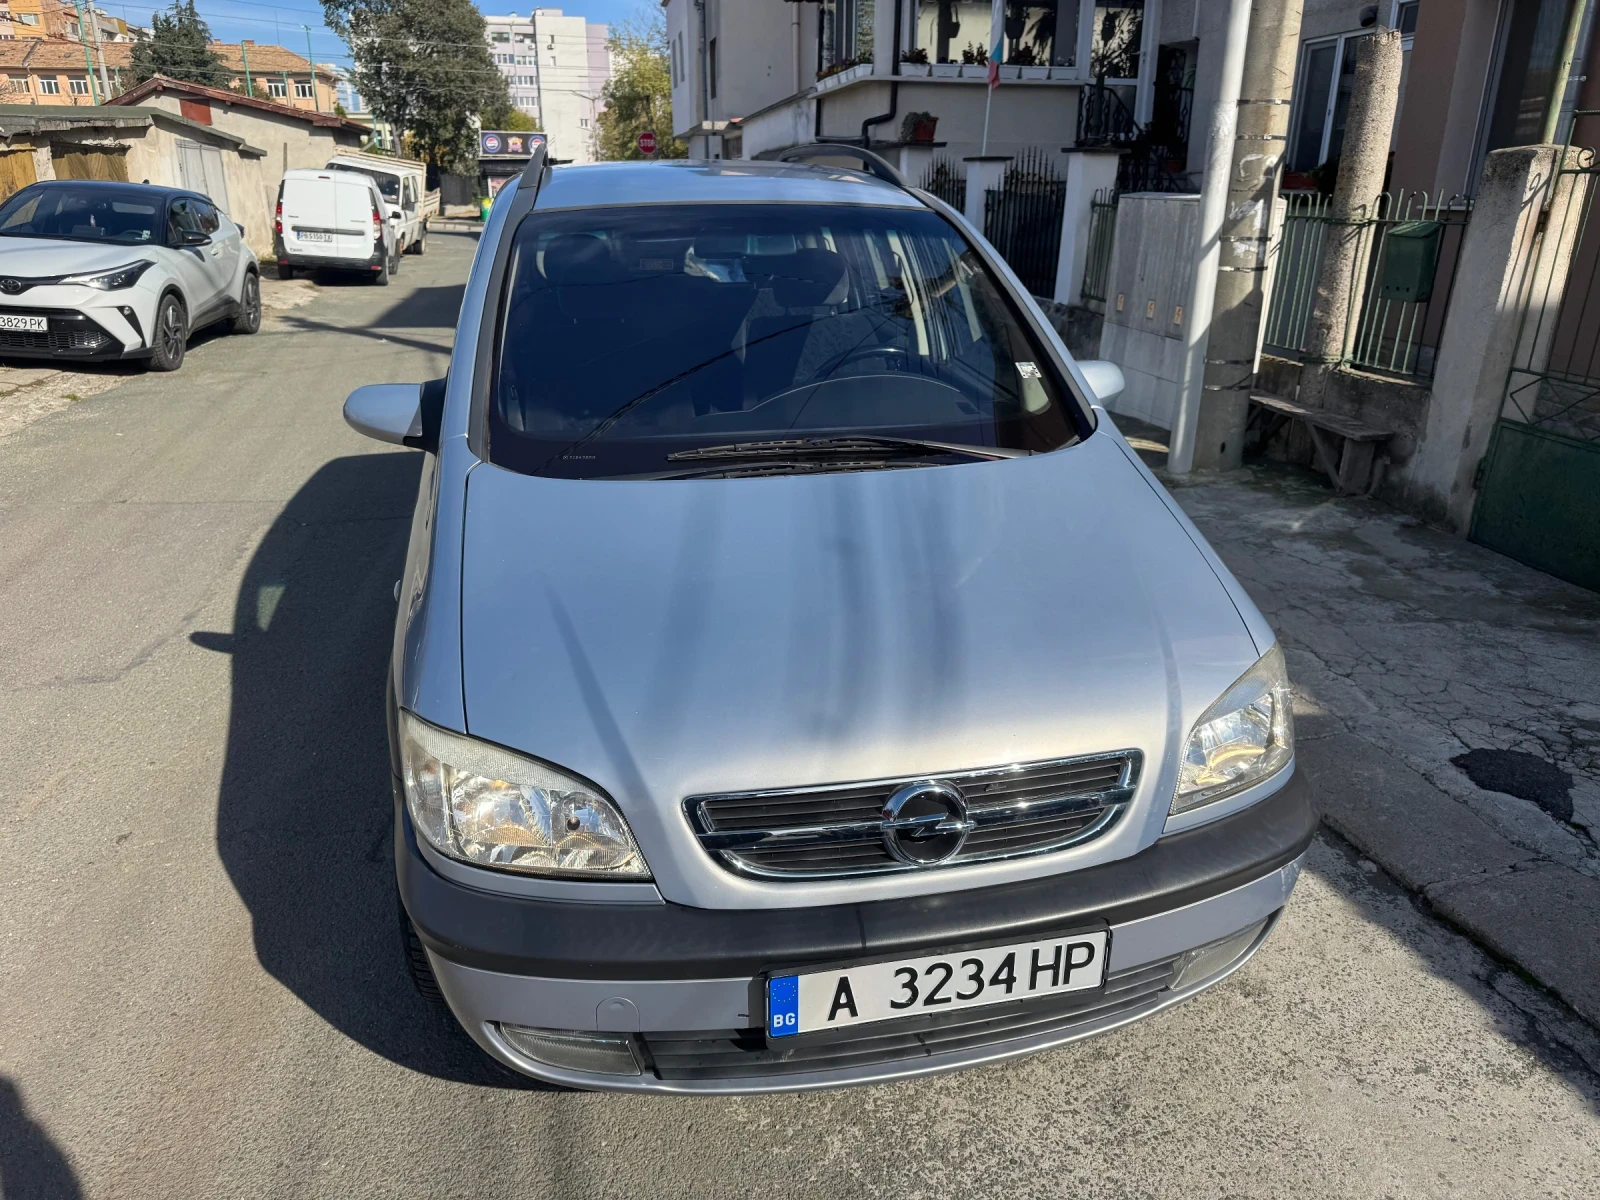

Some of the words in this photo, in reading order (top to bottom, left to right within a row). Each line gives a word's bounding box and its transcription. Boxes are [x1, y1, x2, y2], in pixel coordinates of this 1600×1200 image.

[0, 316, 27, 328] 3829
[30, 318, 44, 329] PK
[826, 975, 859, 1022] A
[890, 952, 1017, 1010] 3234
[1028, 941, 1096, 991] HP
[773, 1012, 796, 1028] BG
